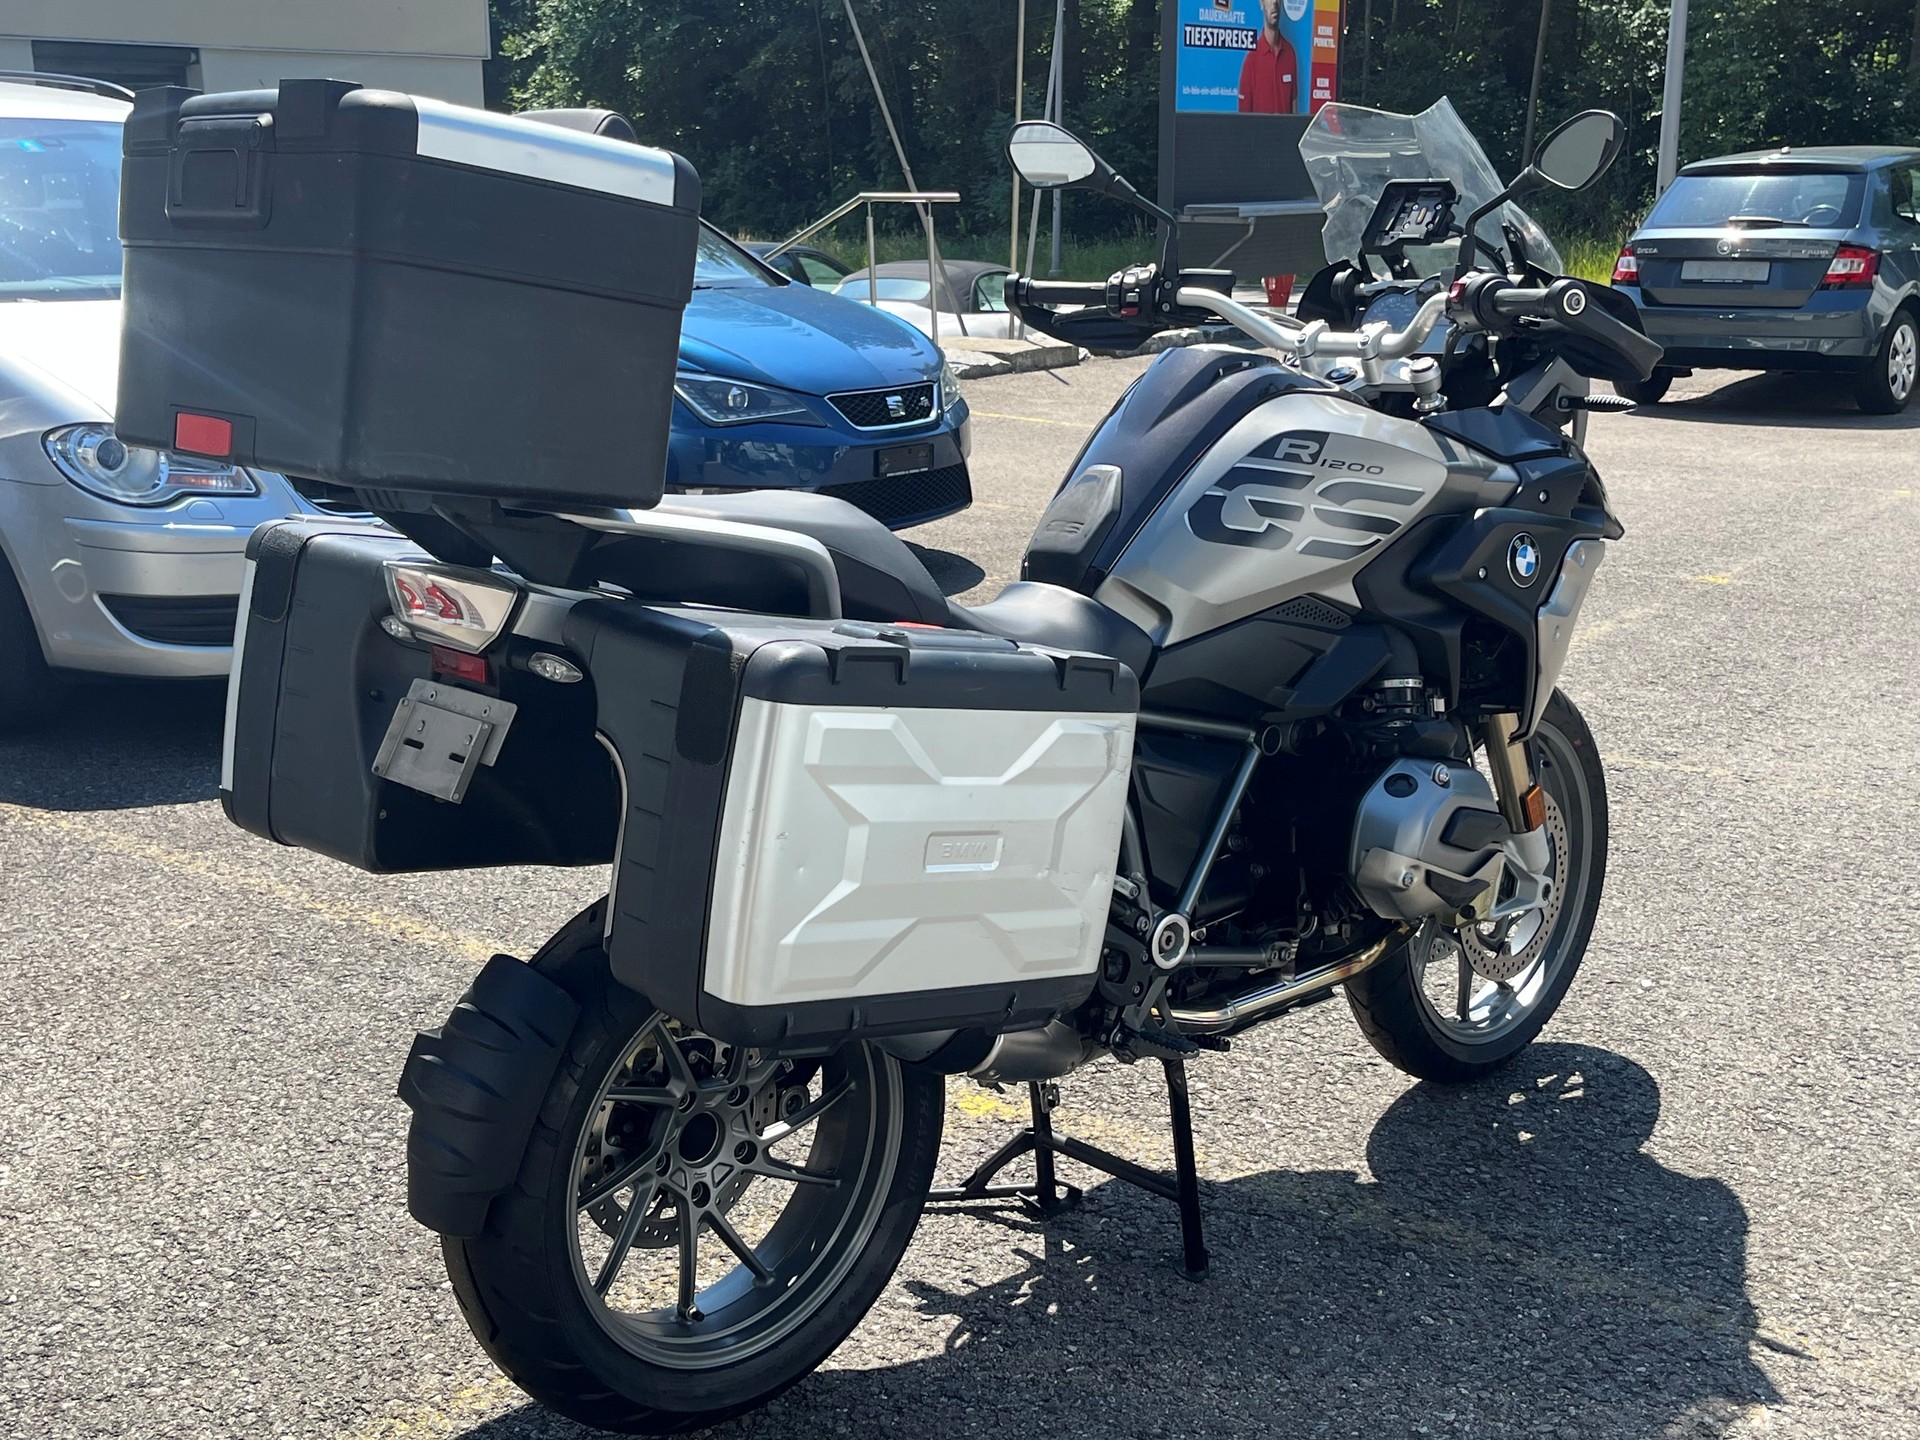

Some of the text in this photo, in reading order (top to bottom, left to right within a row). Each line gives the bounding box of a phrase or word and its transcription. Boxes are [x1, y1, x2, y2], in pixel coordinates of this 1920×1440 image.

[1199, 8, 1245, 24] DAUERHAFTE
[1184, 26, 1257, 49] TIEFSTPREISE.
[941, 842, 987, 858] BMW
